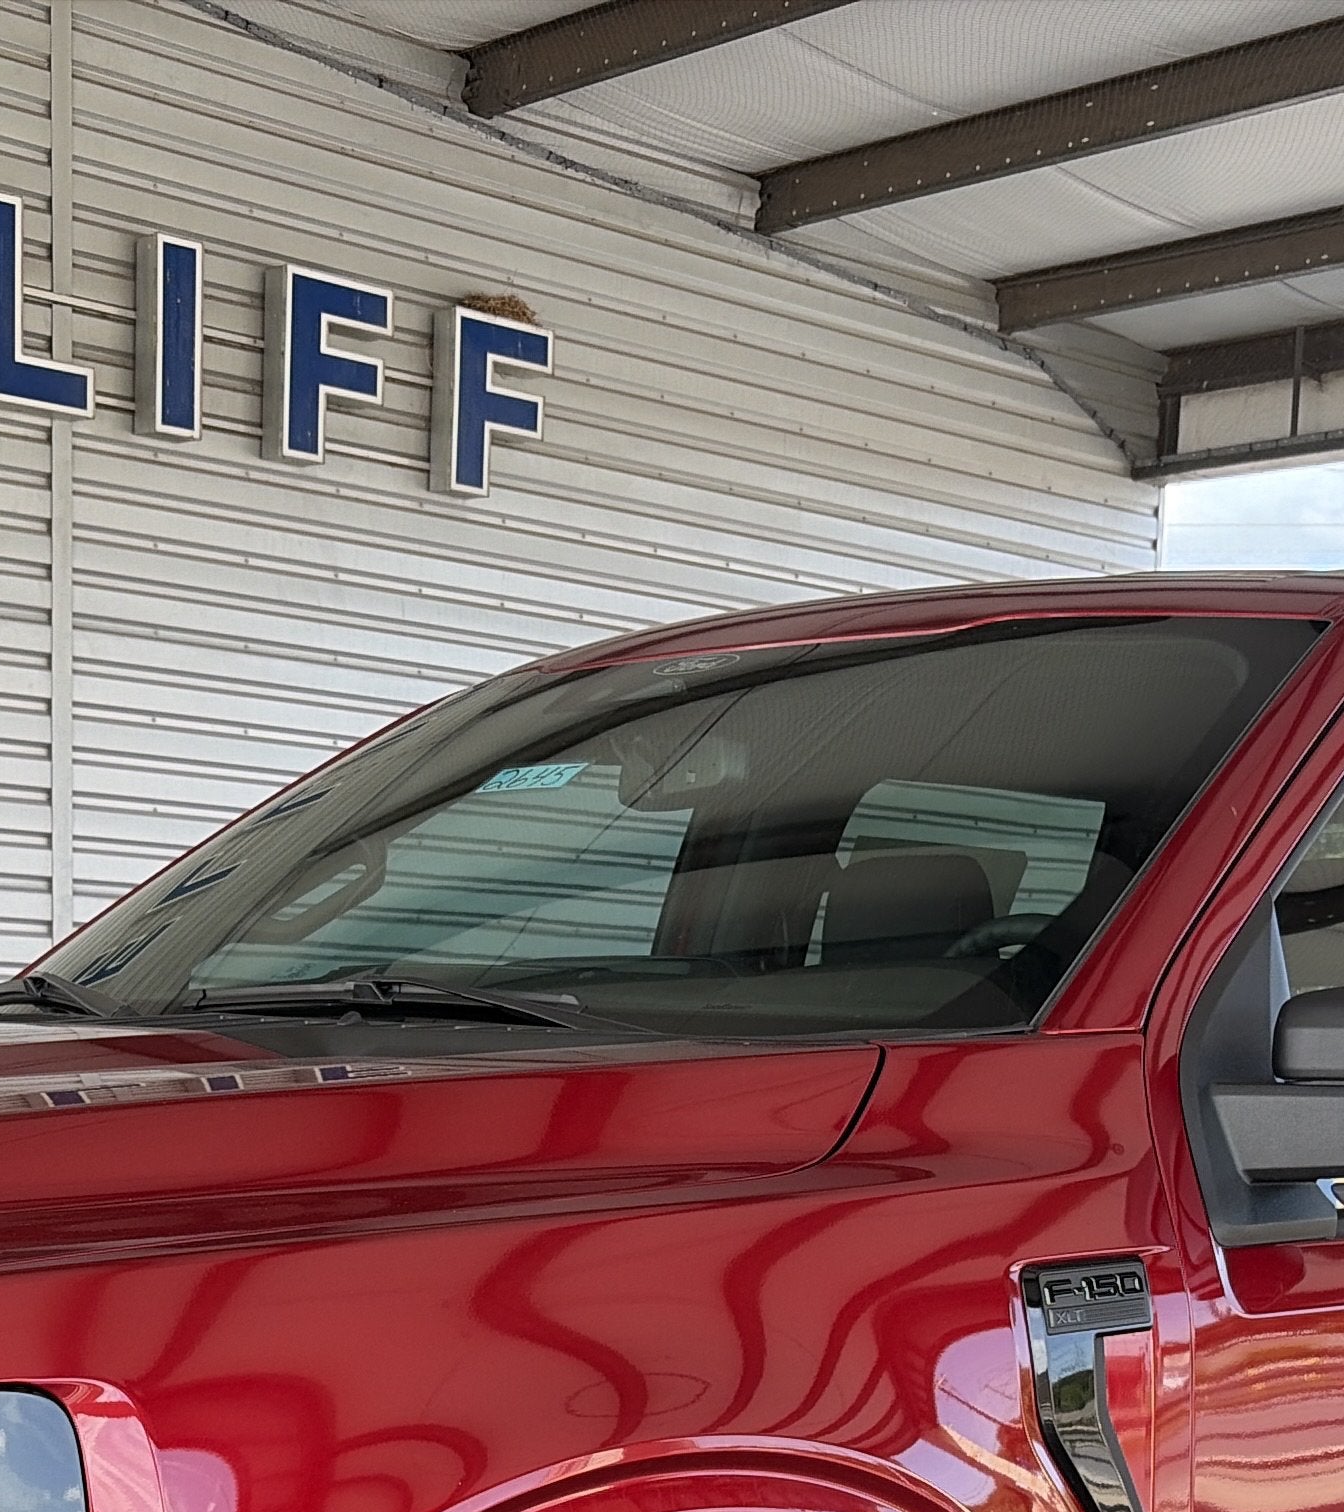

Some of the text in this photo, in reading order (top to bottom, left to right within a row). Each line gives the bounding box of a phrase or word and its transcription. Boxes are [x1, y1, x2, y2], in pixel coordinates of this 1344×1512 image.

[482, 766, 582, 791] 2645
[1042, 1270, 1145, 1306] F-150
[1055, 1309, 1084, 1325] XLT
